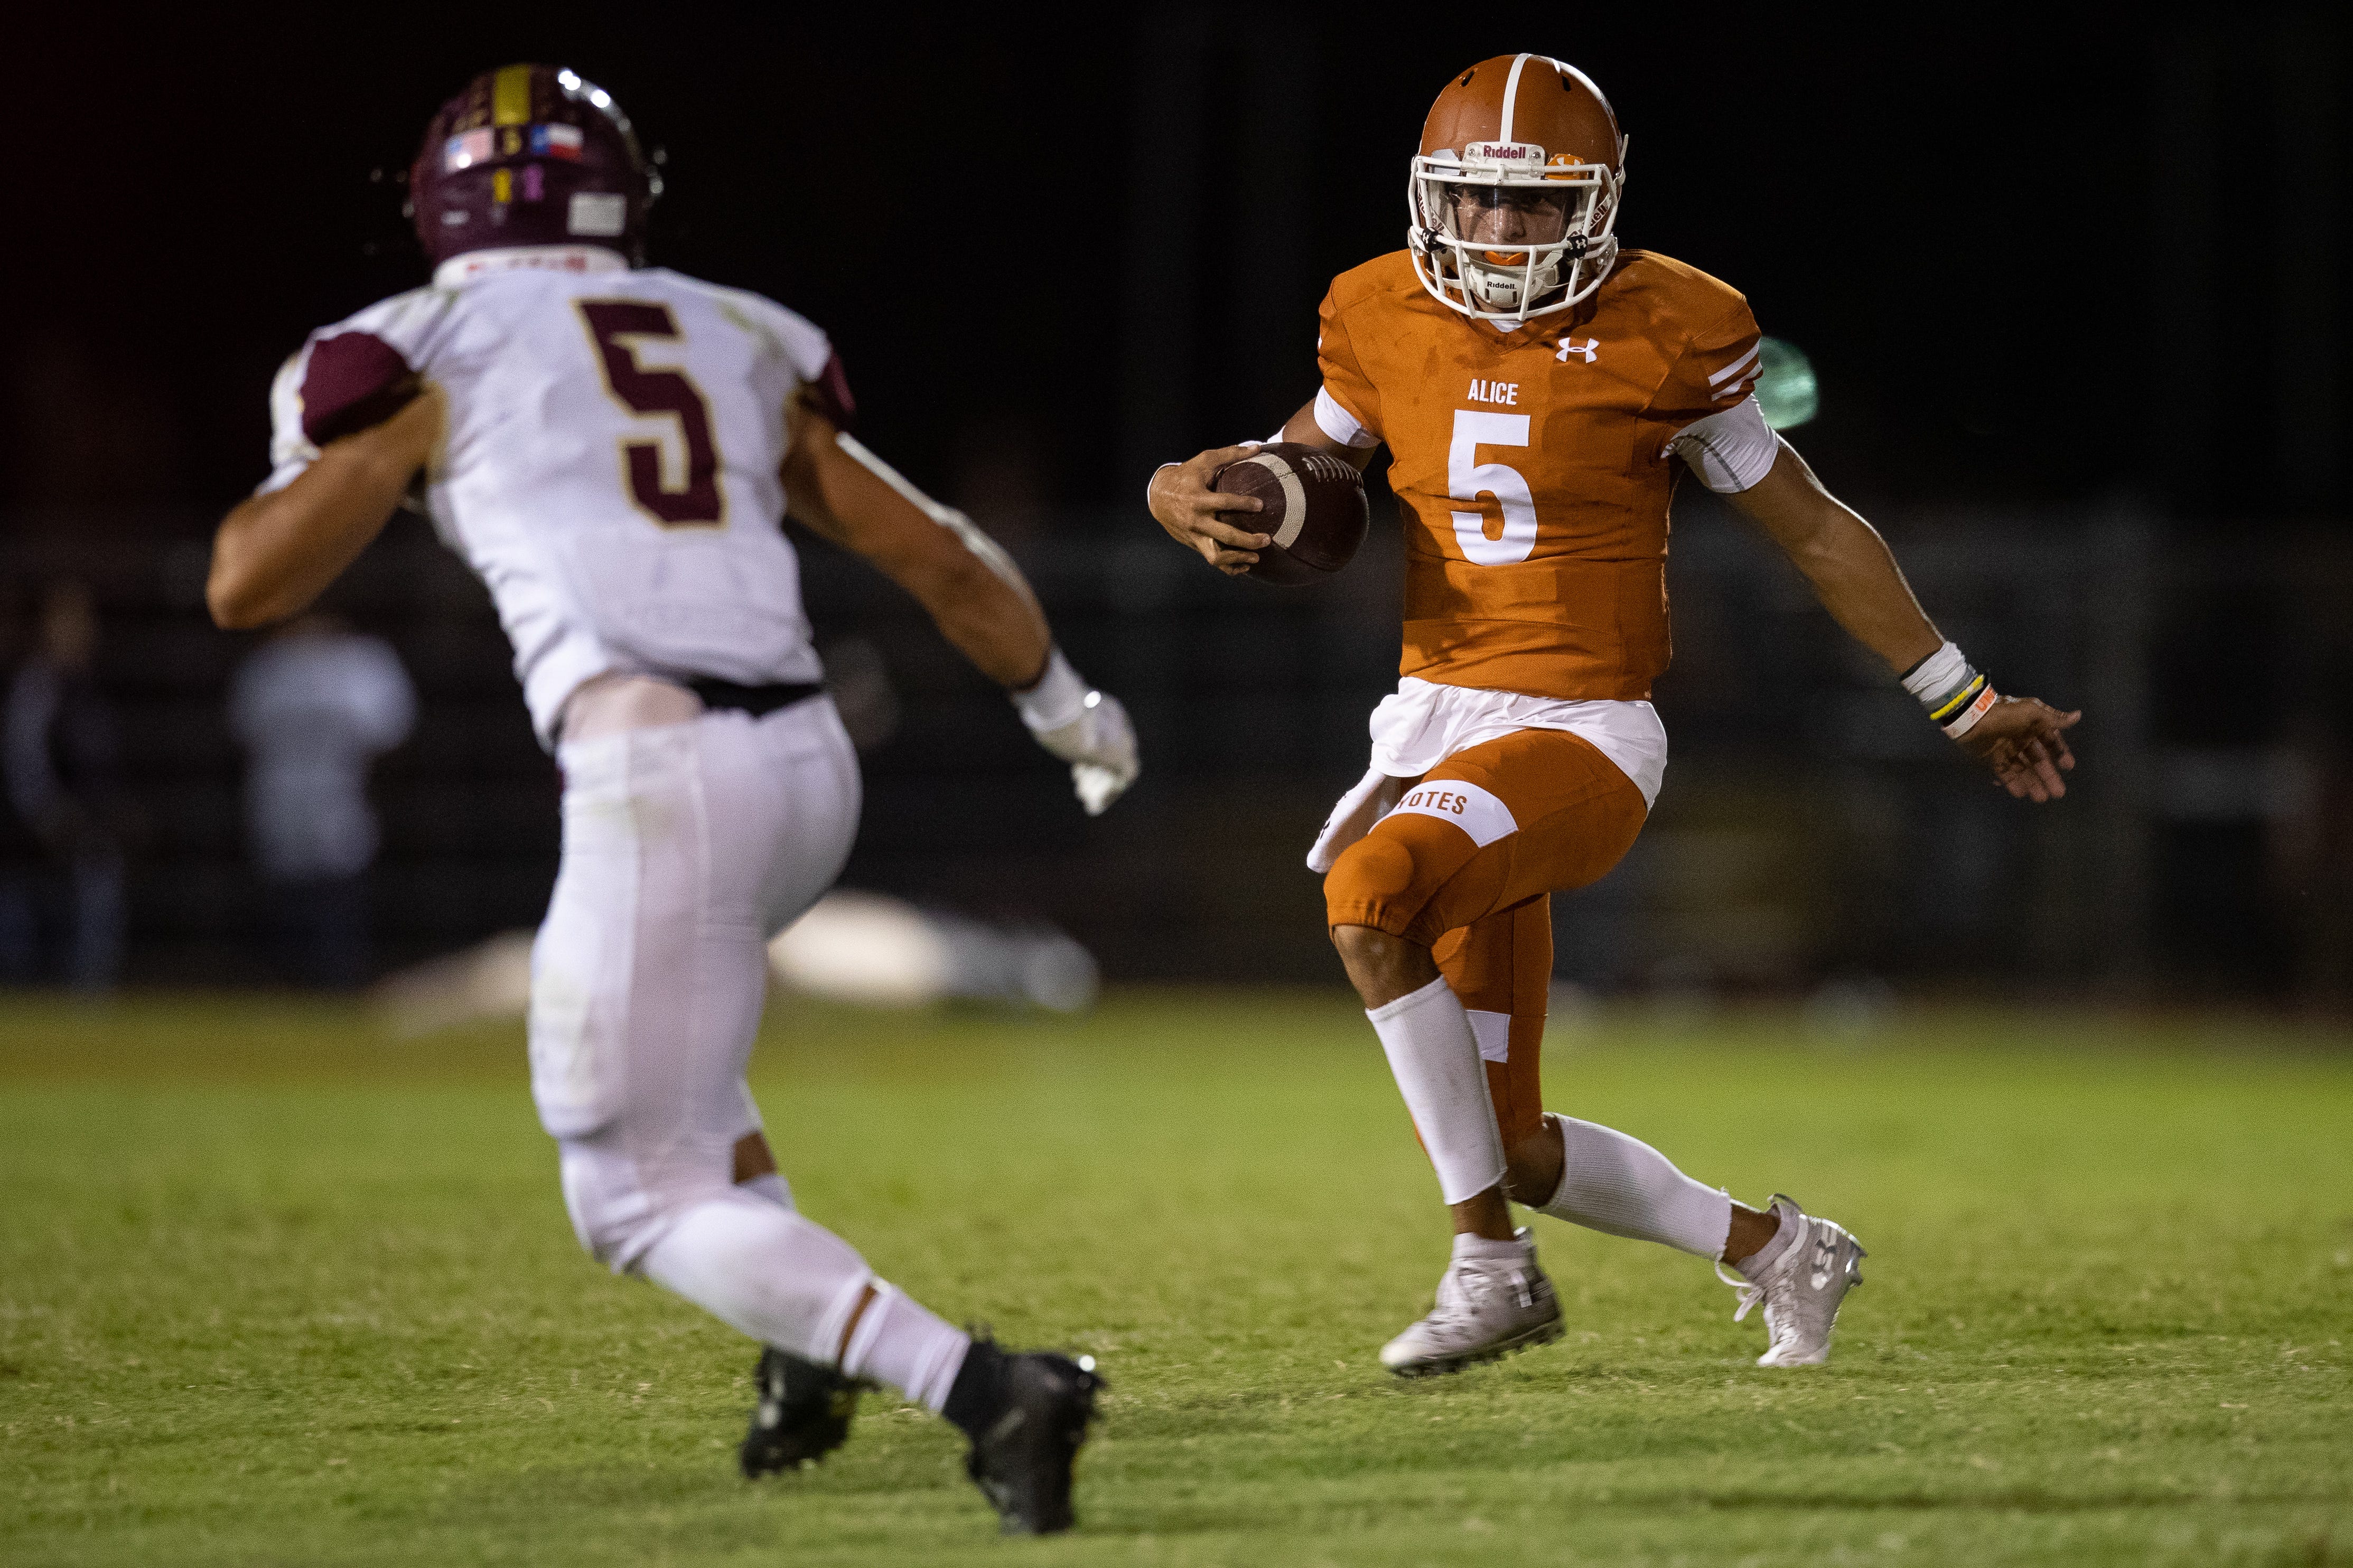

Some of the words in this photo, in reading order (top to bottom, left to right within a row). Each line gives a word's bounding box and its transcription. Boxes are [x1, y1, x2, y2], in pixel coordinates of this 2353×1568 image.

[1483, 145, 1526, 158] Riddell
[1487, 281, 1515, 289] Riddell
[1467, 379, 1519, 406] ALICE
[571, 295, 729, 531] 5
[1448, 409, 1538, 566] 5
